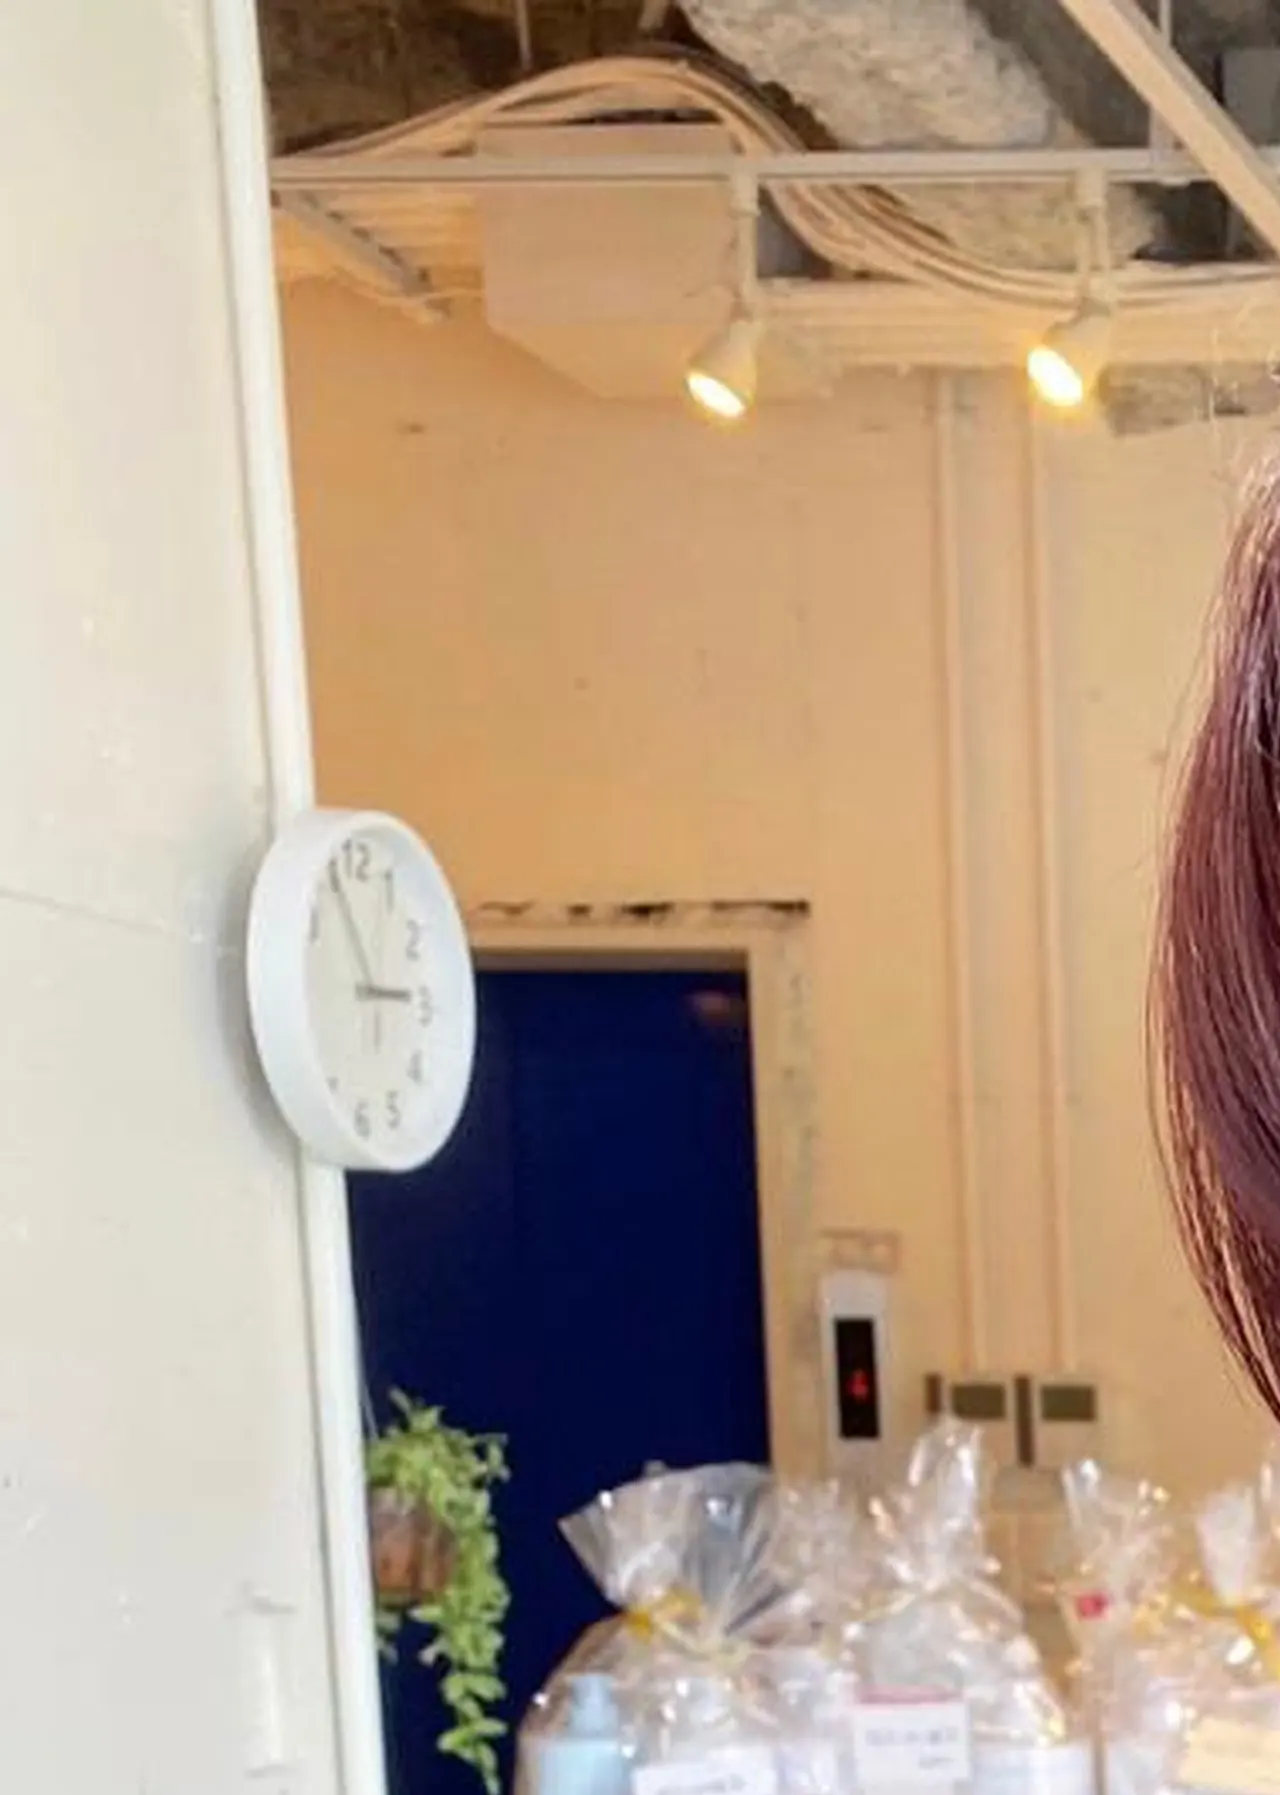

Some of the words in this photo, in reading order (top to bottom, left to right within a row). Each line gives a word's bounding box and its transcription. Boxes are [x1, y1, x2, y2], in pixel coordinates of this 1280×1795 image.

[341, 838, 371, 882] 12
[382, 870, 394, 914] 1
[405, 919, 420, 960] 2
[419, 985, 432, 1028] 3
[406, 1049, 423, 1085] 4
[354, 1099, 371, 1141] 6
[385, 1090, 401, 1130] 5
